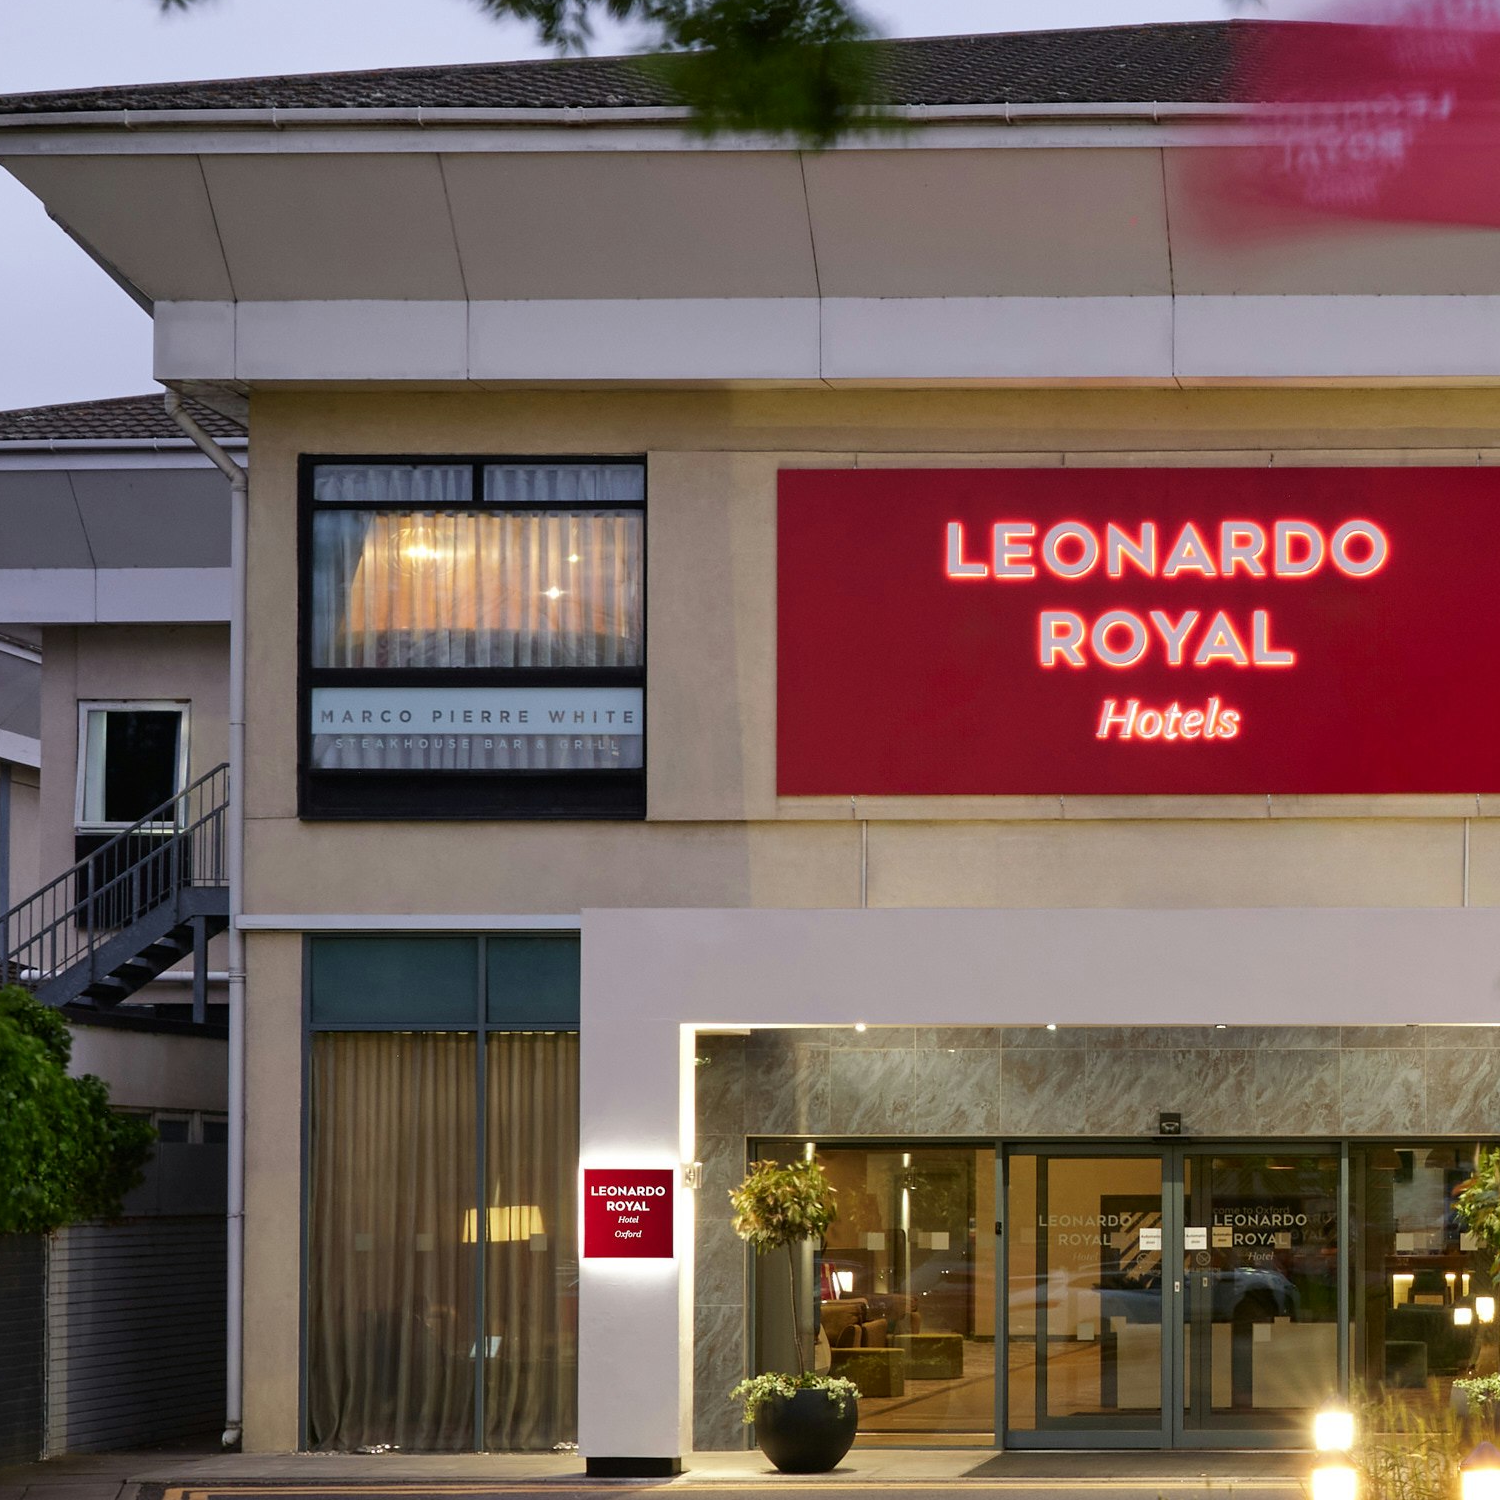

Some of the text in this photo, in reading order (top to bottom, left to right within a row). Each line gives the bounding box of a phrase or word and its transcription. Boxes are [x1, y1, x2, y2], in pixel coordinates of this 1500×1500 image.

[946, 520, 1388, 577] LEONARDO
[1040, 610, 1296, 666] ROYAL
[321, 710, 634, 724] MARCO PIERRE WHITE
[1097, 697, 1241, 739] Hotels
[335, 738, 470, 749] STEAKHOUSE
[484, 738, 522, 749] BAR
[591, 1186, 666, 1196] LEONARDO
[606, 1201, 650, 1211] ROYAL
[618, 1216, 639, 1224] Hotel
[1039, 1215, 1133, 1227] LEONARDO
[1214, 1214, 1308, 1226] LEONARDO
[614, 1230, 642, 1239] Oxford
[1059, 1234, 1112, 1246] ROYAL
[1234, 1233, 1288, 1245] ROYAL
[1248, 1252, 1274, 1261] Hotel
